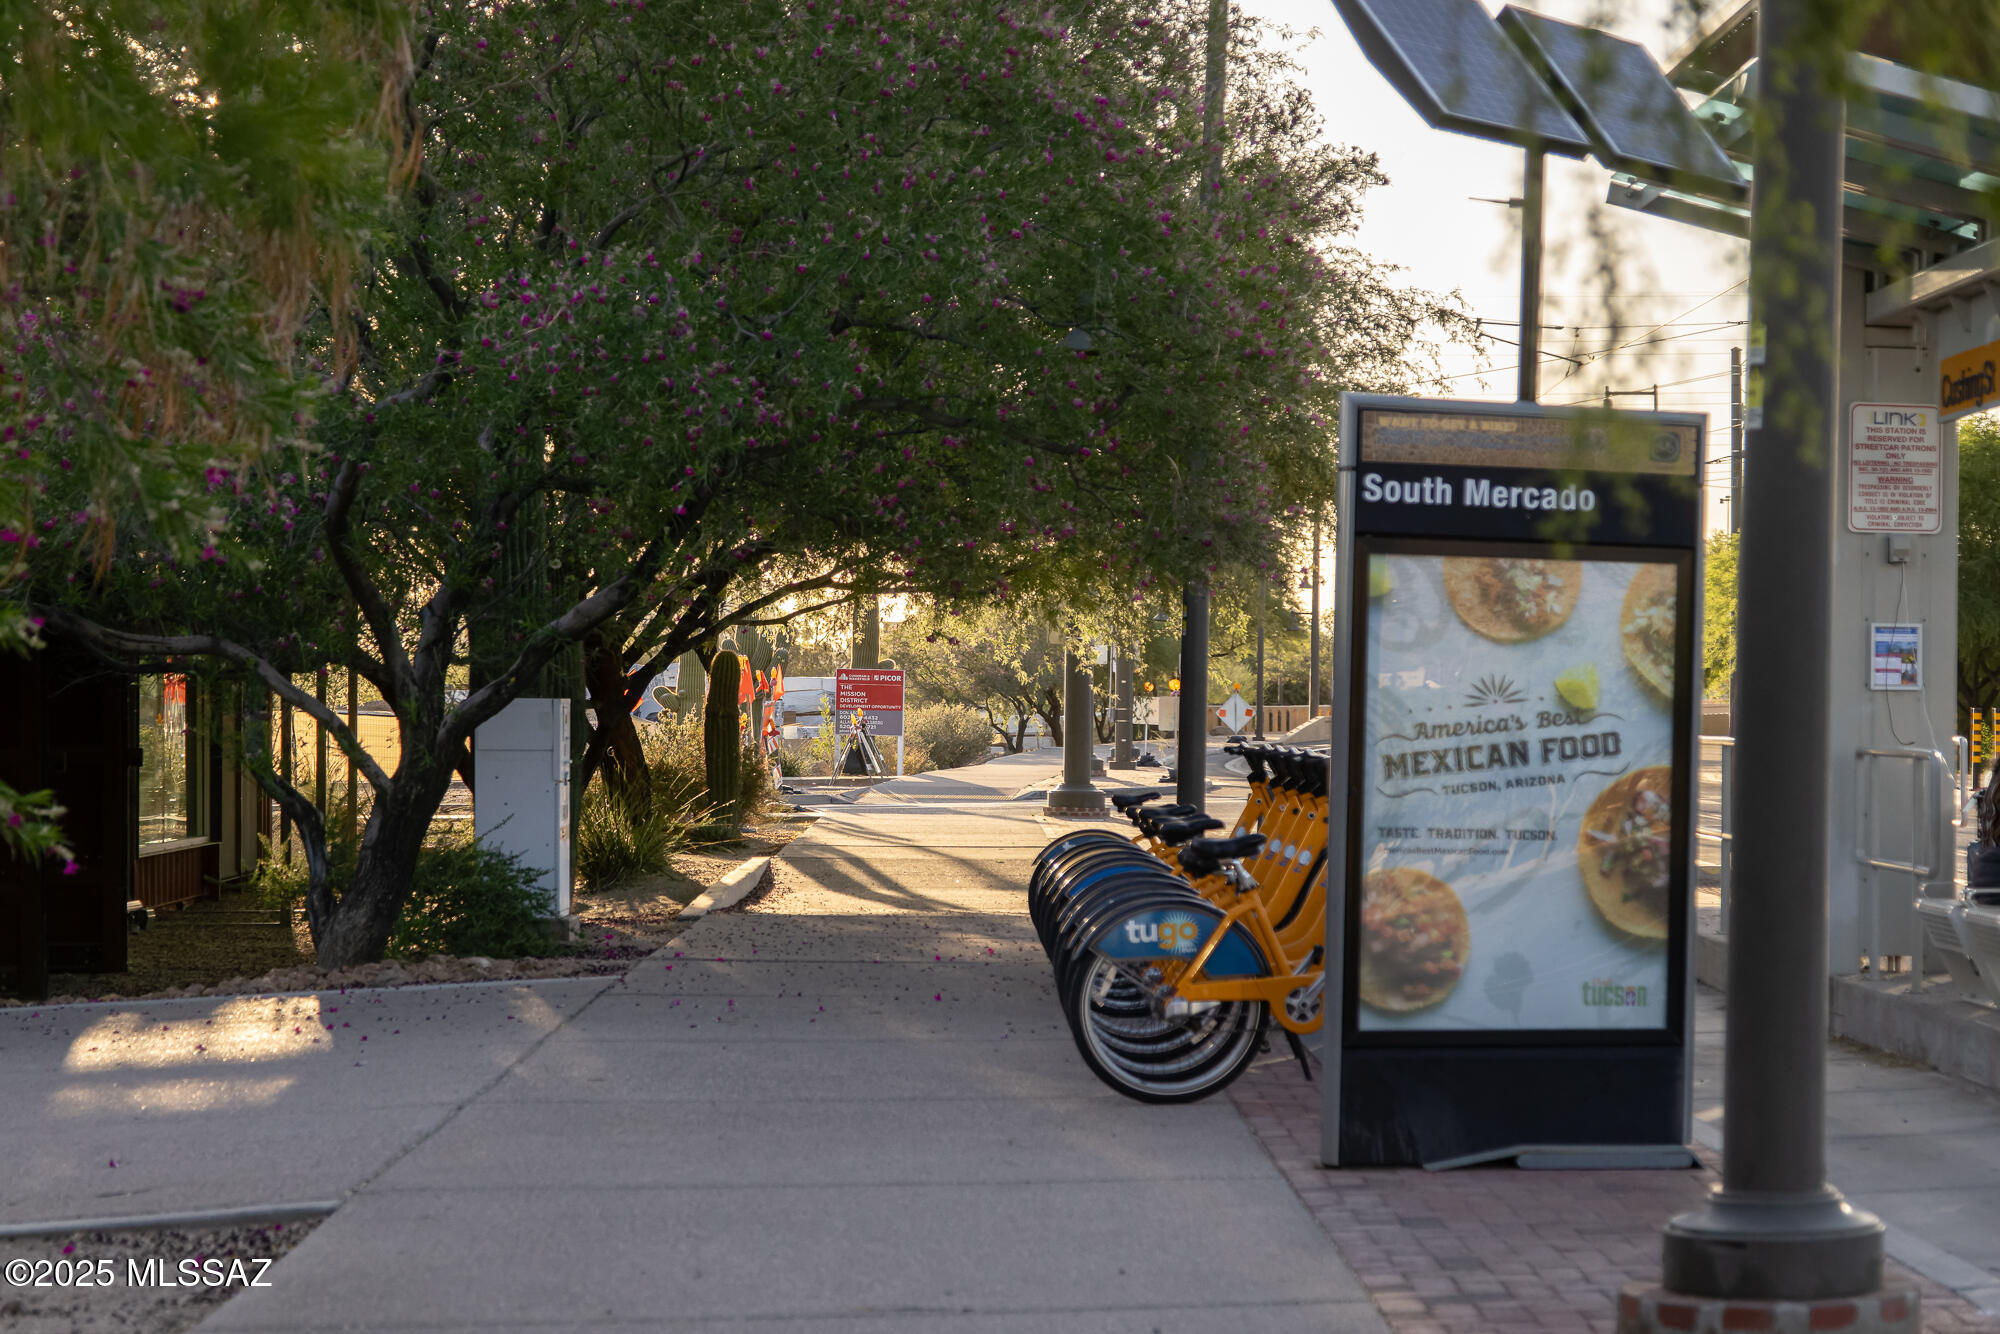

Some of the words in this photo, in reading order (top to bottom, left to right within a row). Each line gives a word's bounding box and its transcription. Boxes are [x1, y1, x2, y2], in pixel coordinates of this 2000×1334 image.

[1885, 427, 1917, 435] STATION
[1867, 435, 1908, 443] RESERVED
[1855, 443, 1899, 451] STREETCAR
[1901, 444, 1937, 452] PATRONS
[1885, 452, 1906, 460] ONLY
[1877, 476, 1914, 484] WARNING
[1362, 473, 1453, 505] South
[1463, 478, 1597, 512] Mercado
[1414, 713, 1527, 740] America's
[1536, 710, 1590, 730] Best
[1383, 739, 1530, 780] MEXICAN
[1538, 730, 1622, 765] FOOD
[1441, 780, 1502, 796] TUCSON,
[1505, 773, 1566, 791] ARIZONA
[1427, 827, 1499, 841] TRADITION.
[1125, 919, 1198, 950] tugo
